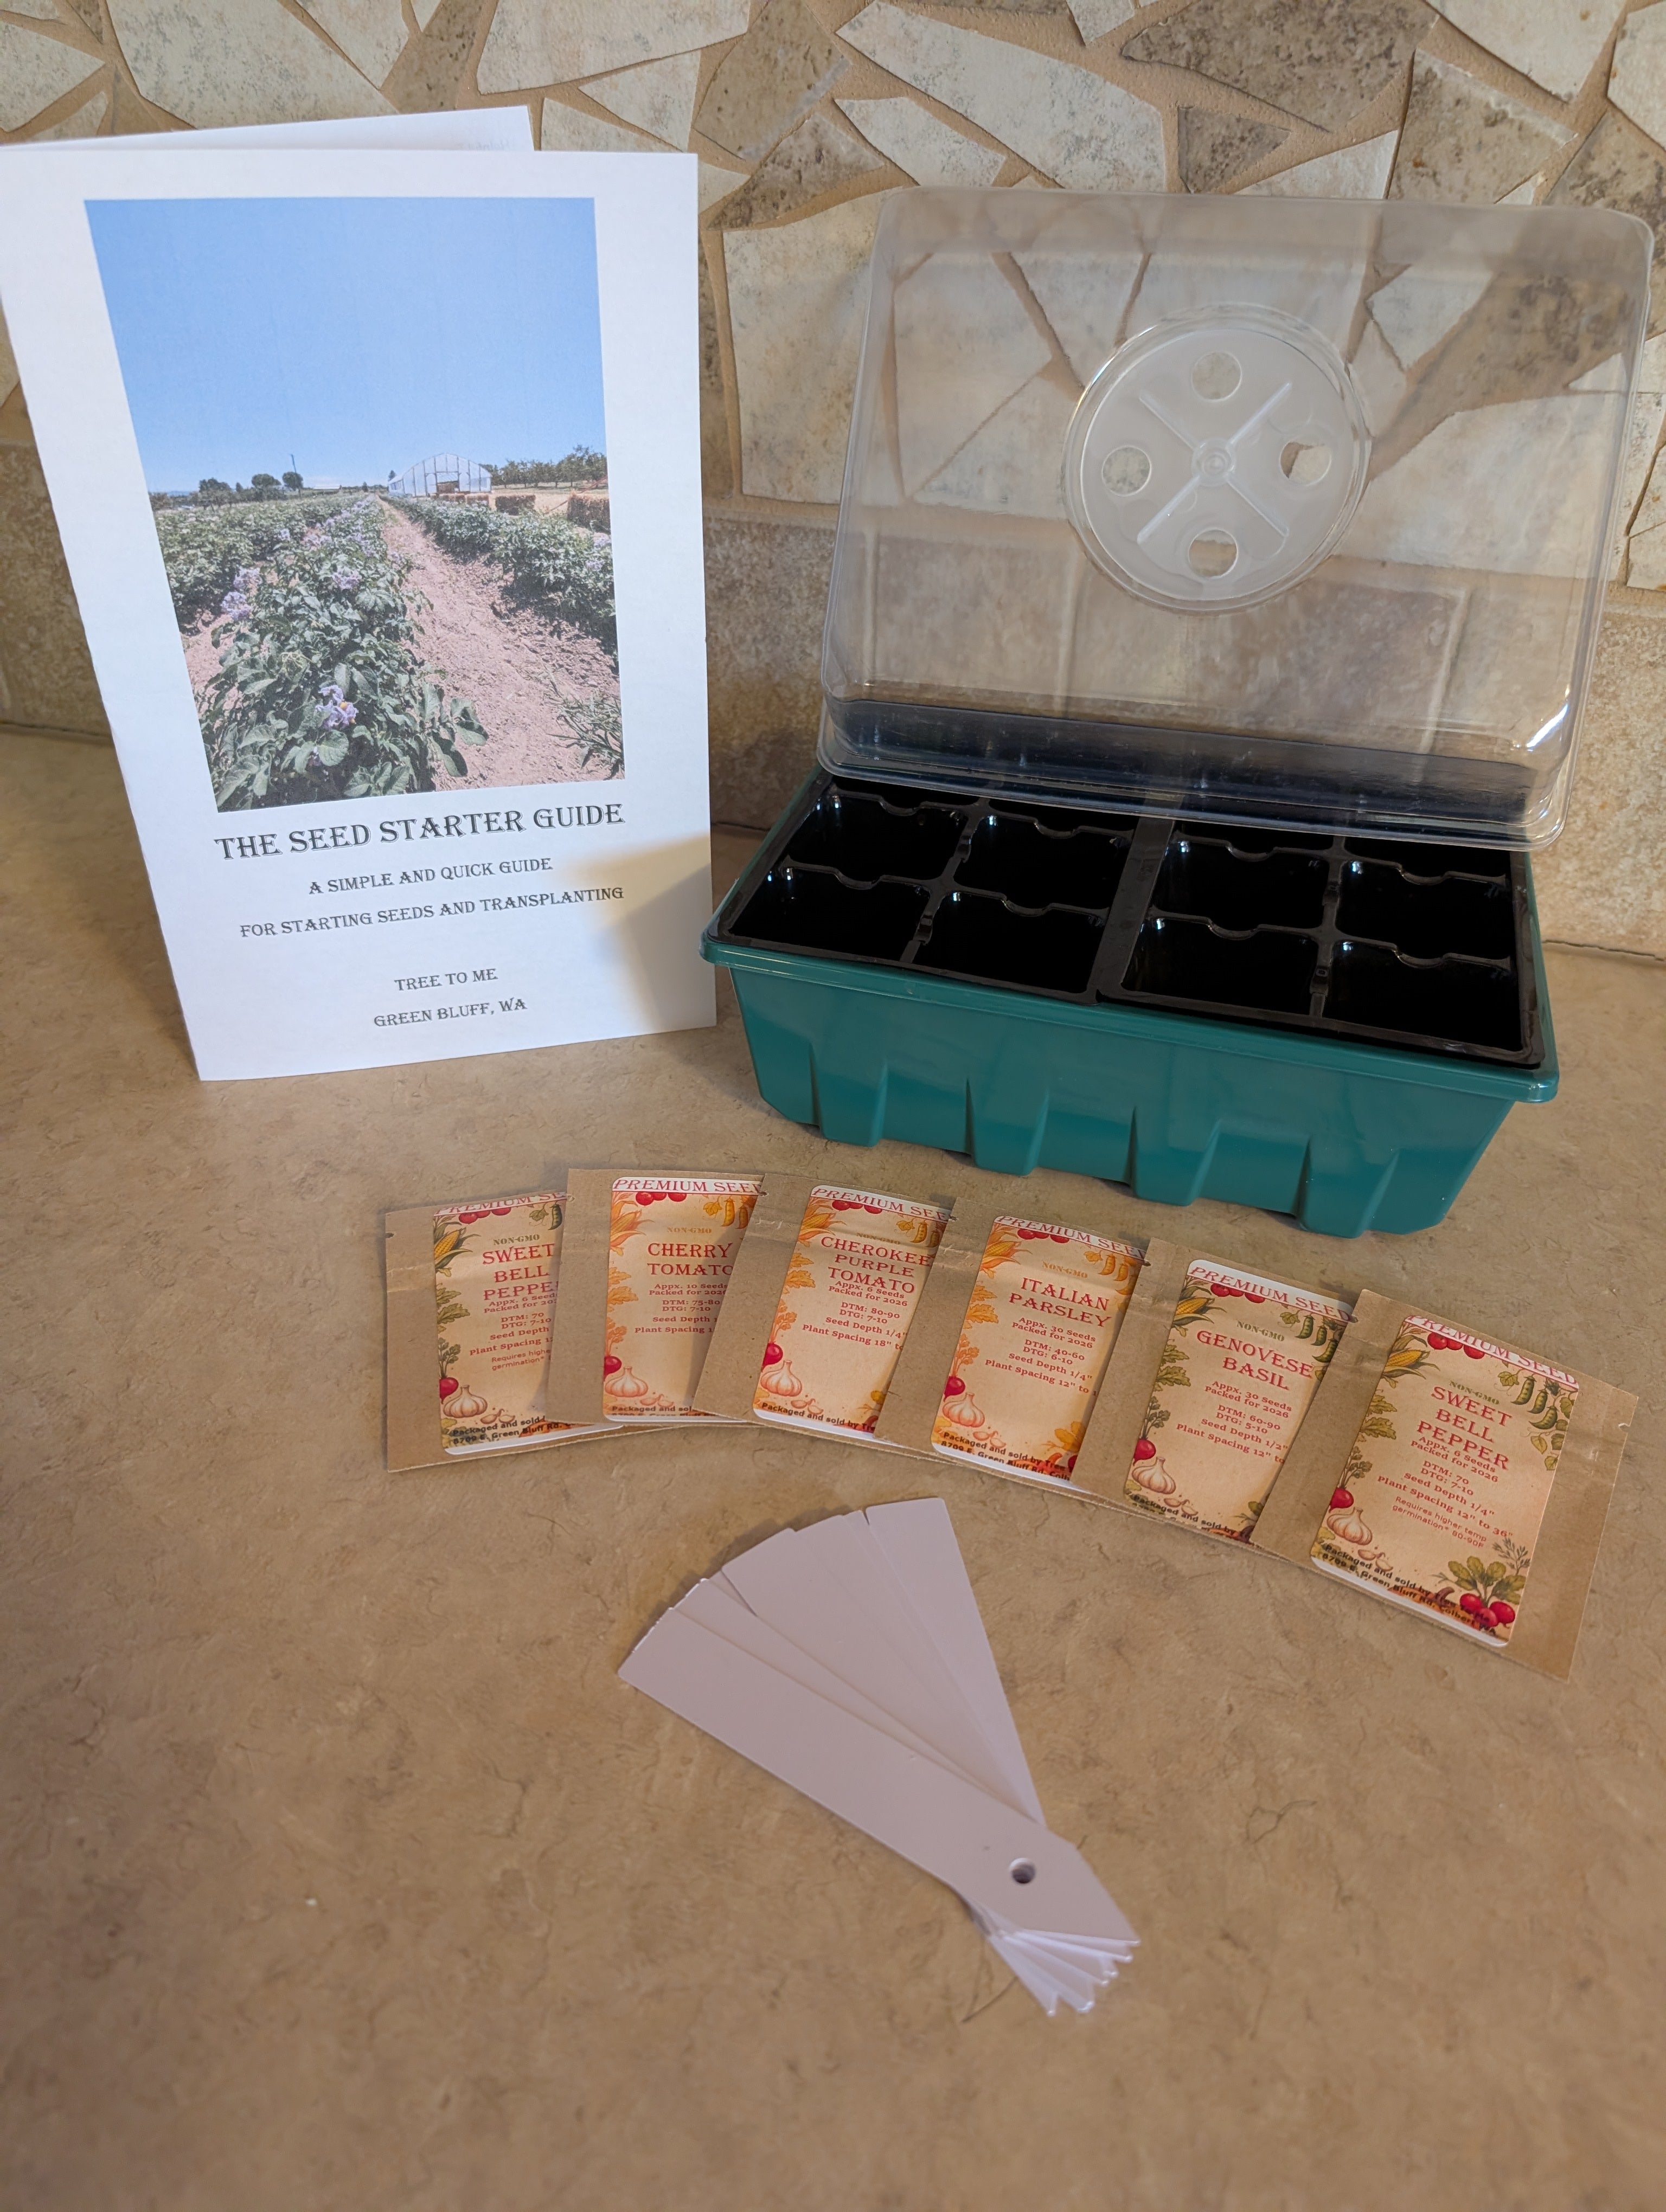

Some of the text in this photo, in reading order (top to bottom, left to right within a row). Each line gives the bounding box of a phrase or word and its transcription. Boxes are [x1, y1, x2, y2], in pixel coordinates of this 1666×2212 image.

[214, 803, 626, 859] THE SEED STARTER GUIDE
[309, 857, 552, 895] A SIMPLE AND QUICK GUIDE
[240, 887, 624, 937] FOR STARTING SEEDS AND TRANSPLANTING
[394, 968, 498, 991] TREE TO ME
[374, 997, 527, 1027] GREEN BLUFF, WA
[613, 1178, 709, 1192] PREMIUM
[812, 1188, 904, 1212] PREMIUM
[493, 1233, 540, 1245] NON-GMO
[856, 1232, 900, 1245] NON-GMO
[998, 1216, 1091, 1242] PREMIUM
[482, 1243, 555, 1264] SWEET
[648, 1243, 733, 1258] CHERRY
[821, 1236, 931, 1268] CHEROKEE
[494, 1265, 550, 1283] BELL
[646, 1262, 733, 1276] TOMATO
[834, 1253, 914, 1277] PURPLE
[1042, 1261, 1087, 1278] NON-GMO
[483, 1280, 558, 1300] PEPPE
[828, 1266, 914, 1293] TOMATO
[835, 1281, 863, 1290] Appx.
[875, 1288, 905, 1298] Seeds
[489, 1298, 518, 1307] Appx.
[829, 1285, 907, 1306] Packed for 2026
[1020, 1277, 1109, 1311] ITALIAN
[1190, 1266, 1352, 1323] PREMIUM SEED
[484, 1303, 519, 1313] Packed
[501, 1314, 528, 1322] DTM:
[839, 1308, 887, 1324] DTG: 7-10
[841, 1301, 900, 1319] DTM: 80-90
[1009, 1292, 1111, 1327] PARSLEY
[490, 1326, 549, 1340] Seed Depth
[501, 1317, 552, 1329] DTG: 7-10
[665, 1326, 705, 1334] Spacing
[802, 1323, 829, 1335] Plant
[832, 1330, 870, 1345] Spacing
[825, 1316, 882, 1334] Seed Depth
[1011, 1321, 1092, 1348] Packed for 2026
[1019, 1317, 1047, 1329] Appx.
[1067, 1329, 1095, 1342] Seeds
[1236, 1320, 1284, 1341] NON-GMO
[469, 1339, 542, 1355] Plant Spacing
[491, 1353, 526, 1362] Requires
[1022, 1346, 1073, 1365] DTG: 6-10
[1024, 1339, 1085, 1360] DTM: 40-60
[1196, 1330, 1312, 1379] GENOVESE
[1407, 1316, 1578, 1384] PREMIUM SEED
[985, 1359, 1088, 1393] Plant Spacing 12" to
[1008, 1353, 1092, 1381] Seed Depth 1/4"
[1222, 1356, 1289, 1390] BASIL
[1204, 1385, 1289, 1418] Packed for 2026
[1212, 1380, 1291, 1411] Appx. 30 Seeds
[1449, 1380, 1500, 1405] NON-GMO
[761, 1401, 844, 1427] Packaged and sold
[1218, 1404, 1280, 1430] DTM: 60-90
[1430, 1386, 1513, 1426] SWEET
[453, 1416, 540, 1437] Packaged and sold
[1215, 1411, 1267, 1434] DTG: 5-10
[1435, 1408, 1492, 1443] BELL
[492, 1430, 519, 1440] Green
[943, 1431, 1028, 1462] Packaged and sold
[1176, 1423, 1271, 1457] Plant Spacing 12"
[1201, 1418, 1287, 1454] Seed Depth 1/2"
[1417, 1420, 1509, 1470] PEPPER
[1411, 1440, 1498, 1482] Packed for 2026
[1419, 1436, 1450, 1453] Appx.
[1464, 1455, 1496, 1472] Seeds
[1420, 1467, 1473, 1495] DTG: 7-10
[1423, 1460, 1469, 1484] DTM: 70
[1404, 1472, 1495, 1516] Seed Depth 1/4"
[1377, 1475, 1513, 1539] Plant Spacing 12" to 36"
[1395, 1496, 1486, 1541] Requires higher temp
[1452, 1529, 1484, 1548] 80-90F
